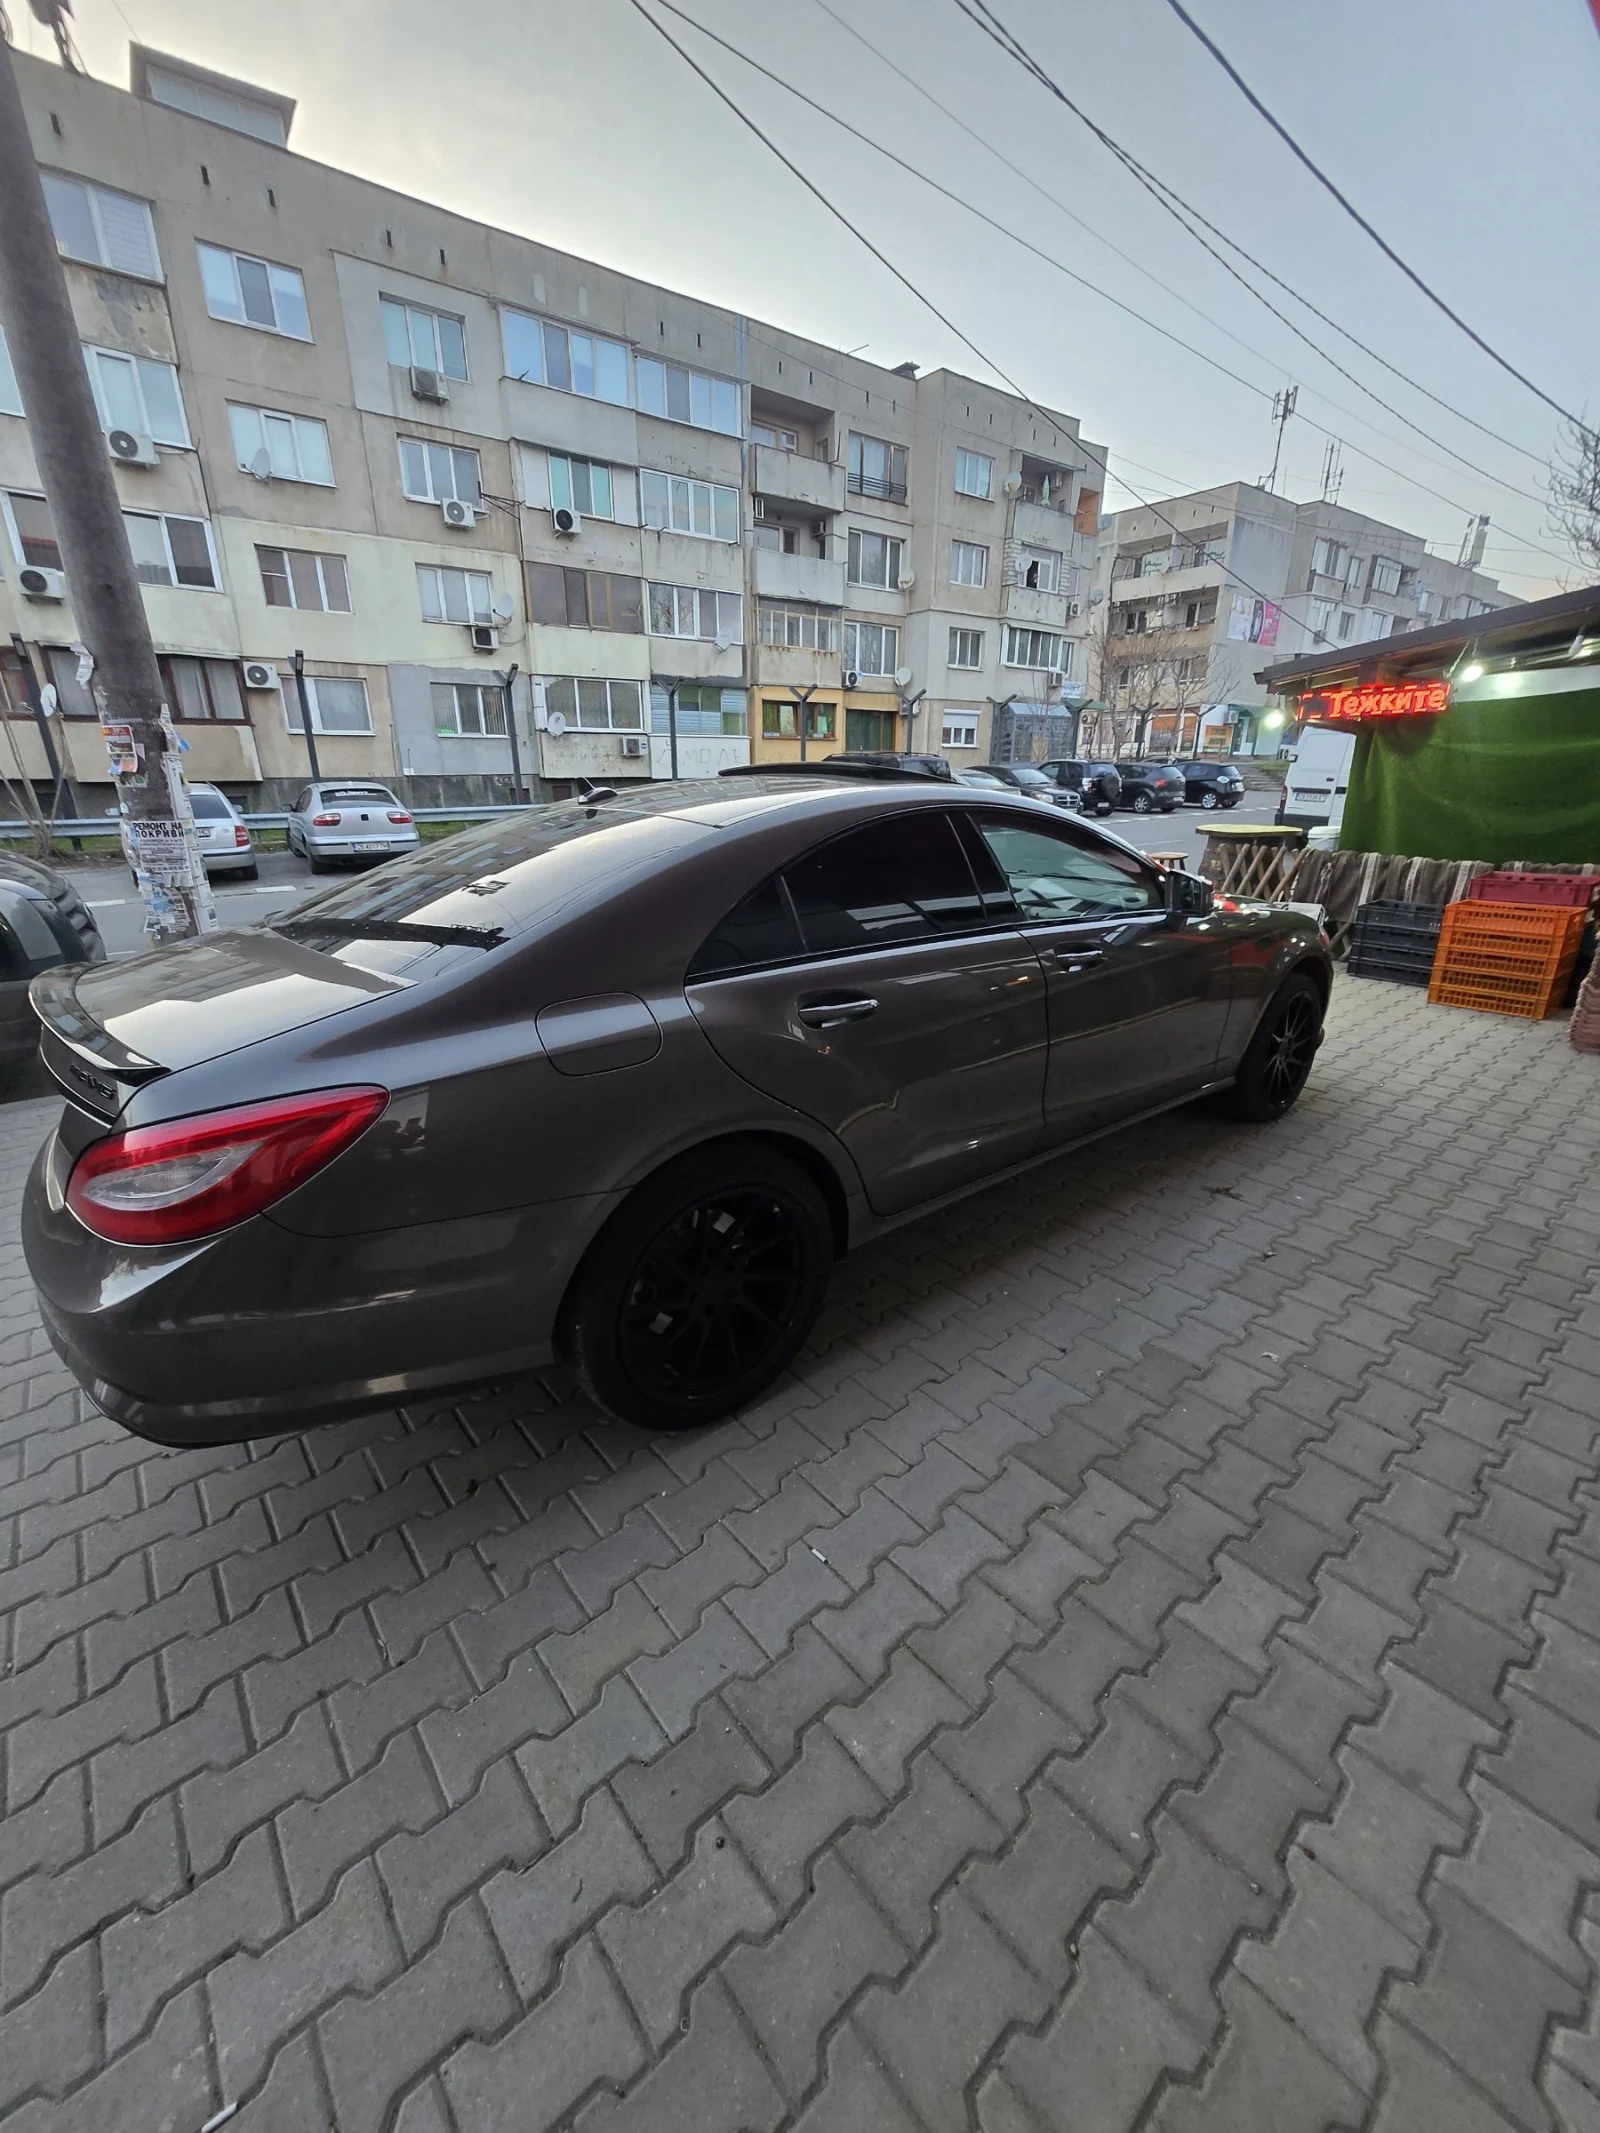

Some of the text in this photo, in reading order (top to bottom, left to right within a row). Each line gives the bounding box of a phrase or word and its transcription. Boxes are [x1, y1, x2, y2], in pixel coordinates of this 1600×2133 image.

[1329, 689, 1446, 718] Тежките
[133, 822, 183, 831] РЕМОНТ НА
